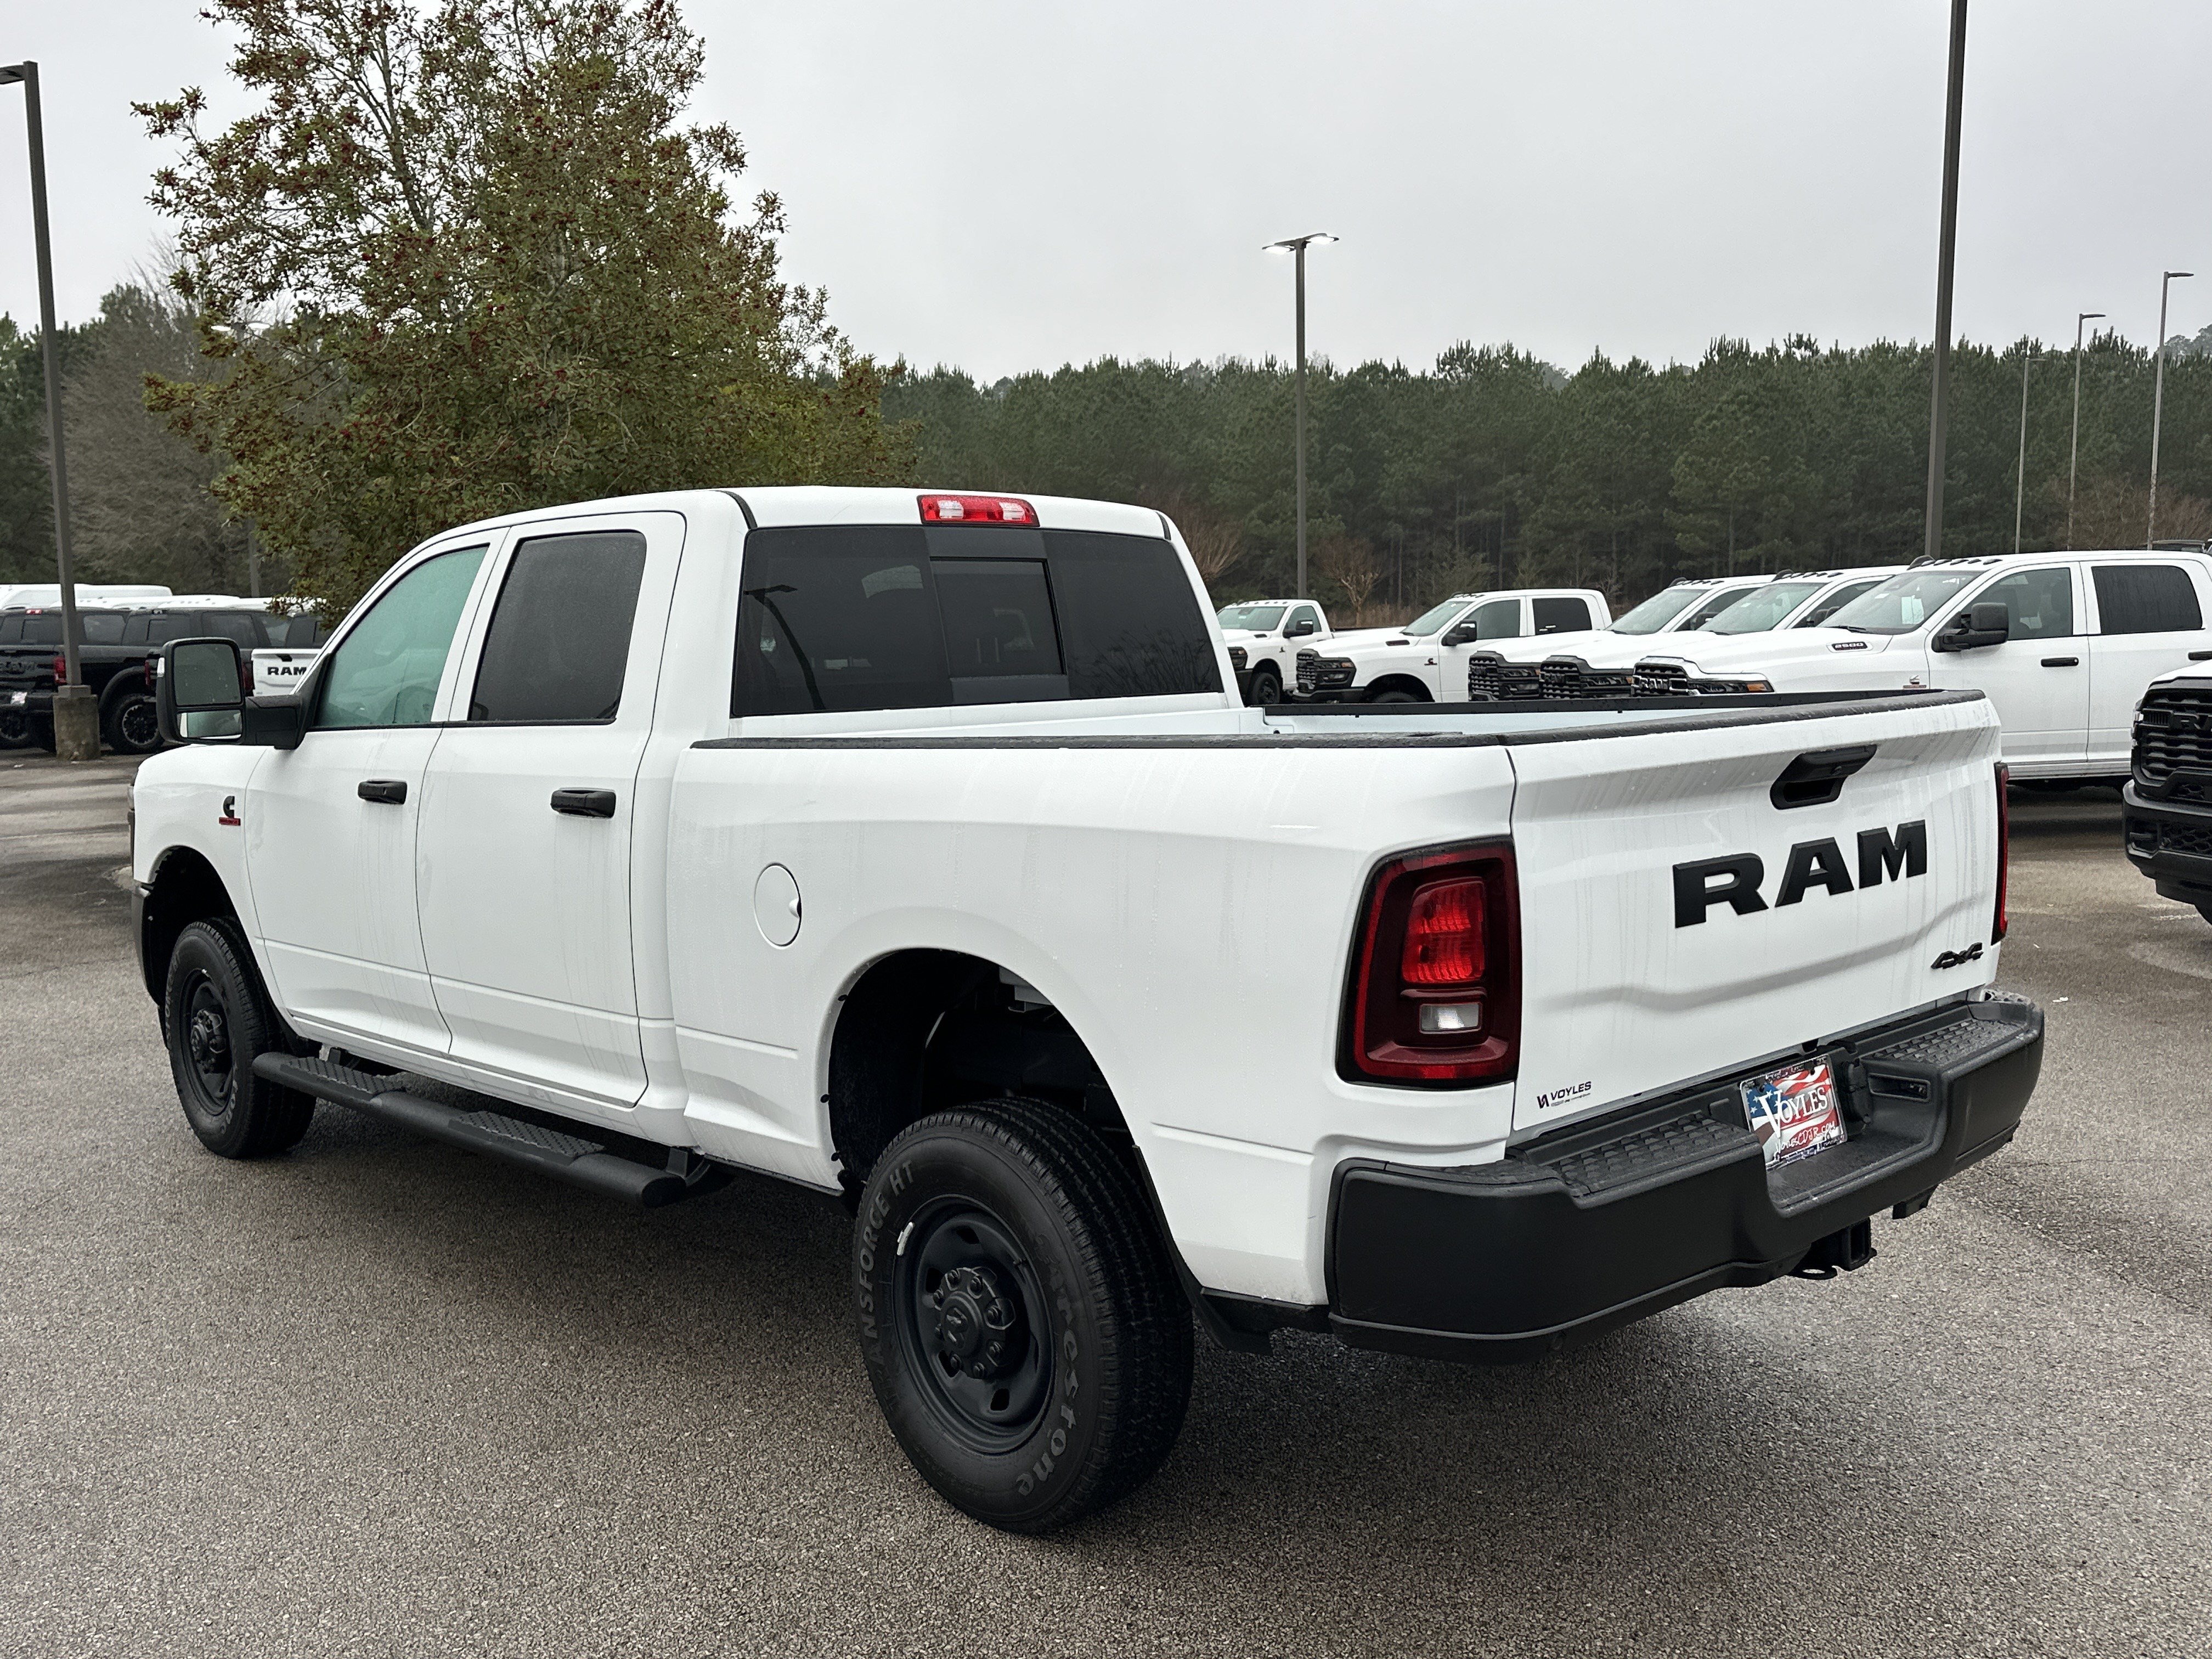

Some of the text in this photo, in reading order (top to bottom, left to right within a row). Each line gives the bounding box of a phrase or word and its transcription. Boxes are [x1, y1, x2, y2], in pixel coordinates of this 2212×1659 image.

[267, 666, 307, 675] RAM
[1673, 819, 1927, 928] RAM
[1550, 1081, 1592, 1101] VOYLES
[889, 1159, 913, 1197] HT
